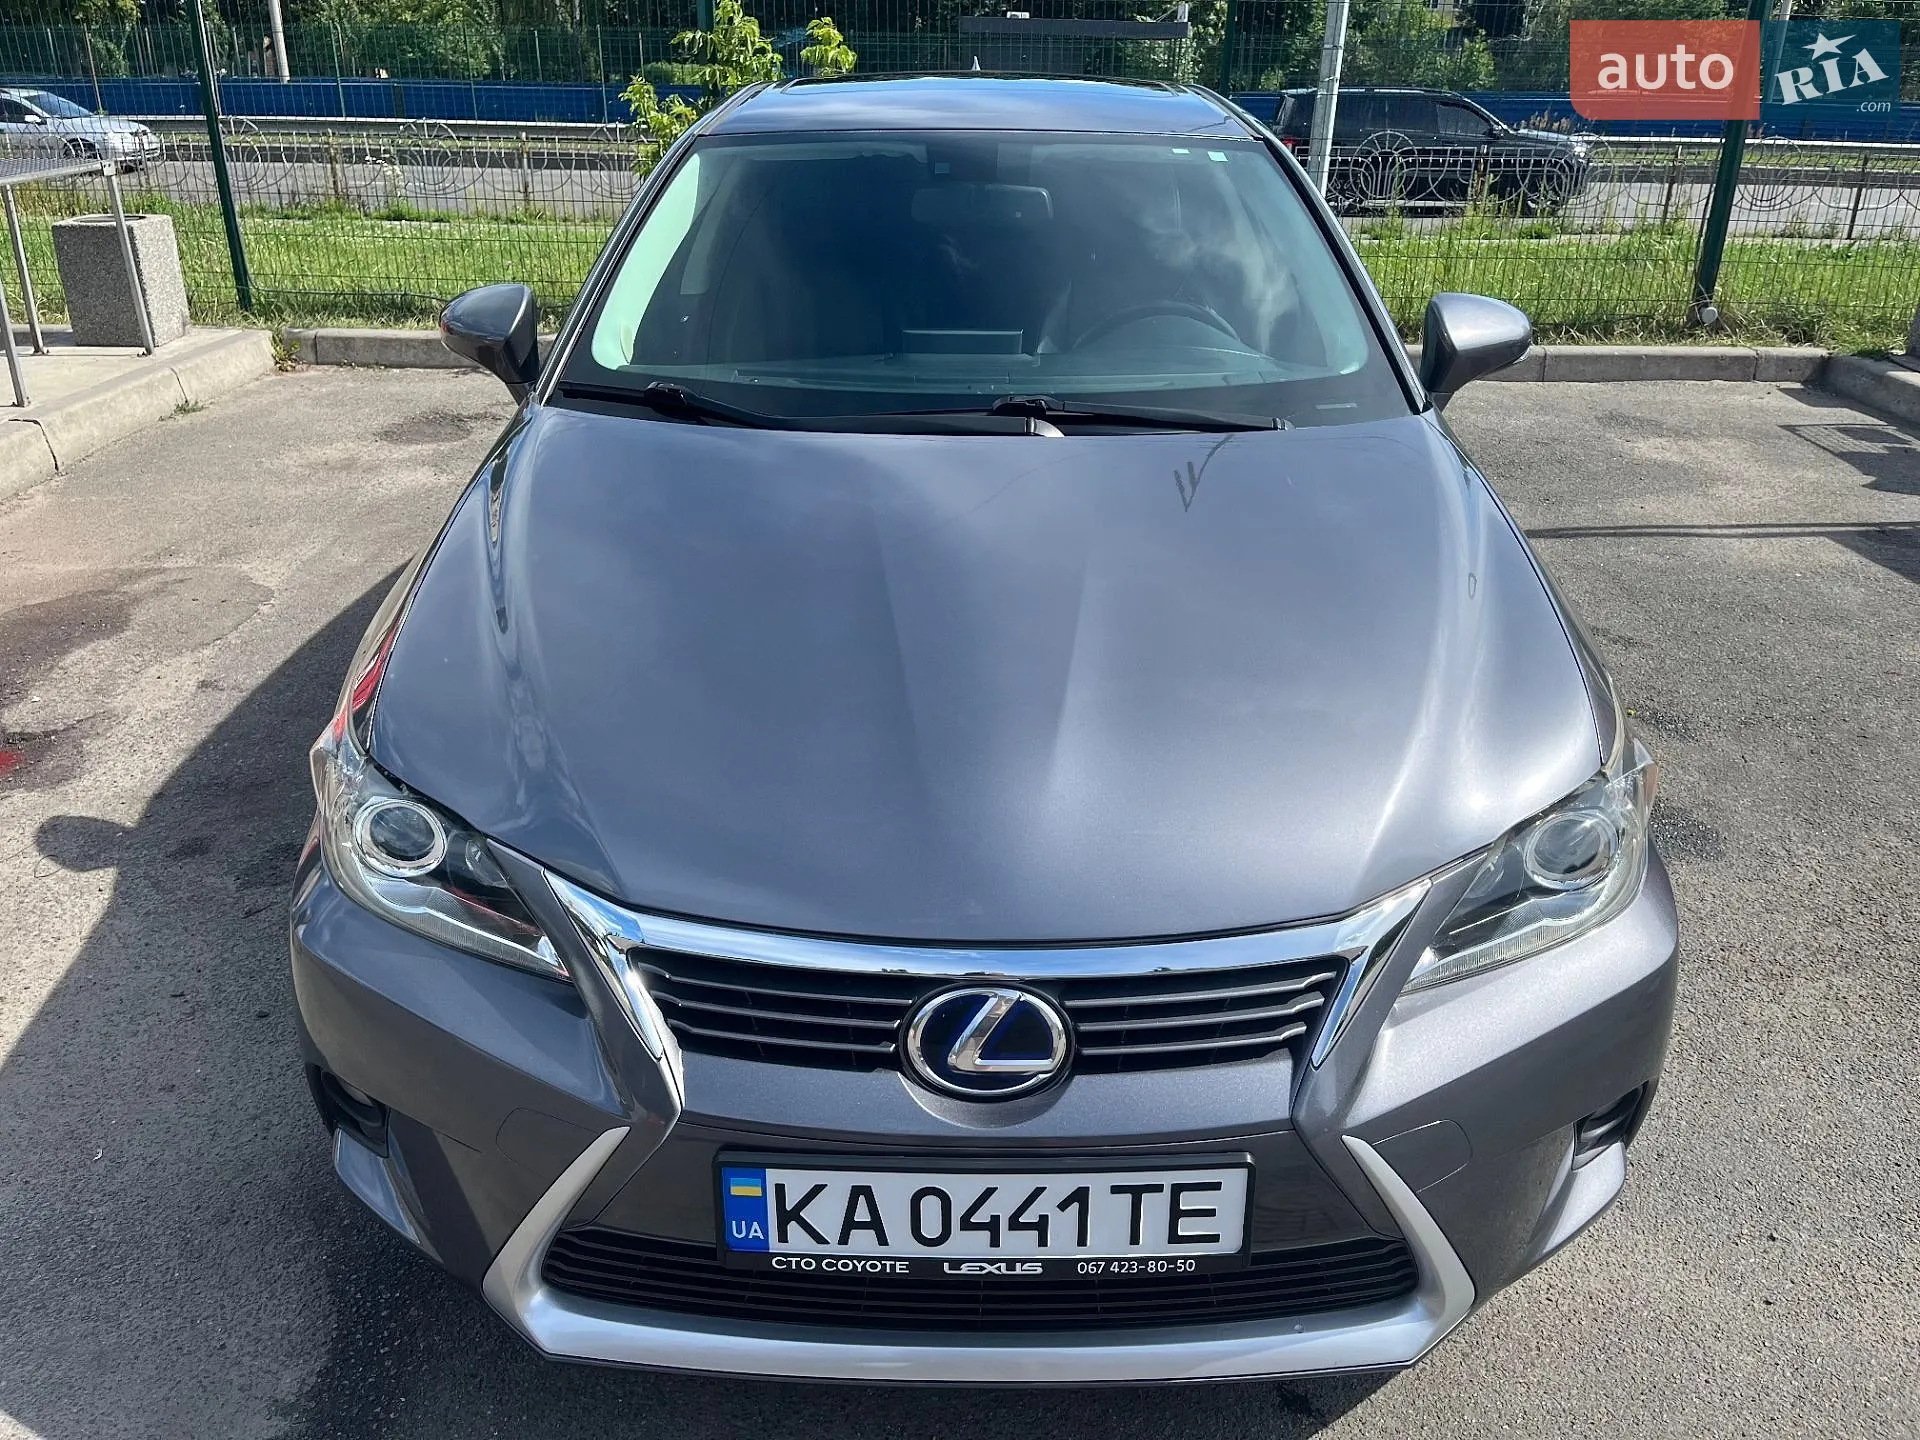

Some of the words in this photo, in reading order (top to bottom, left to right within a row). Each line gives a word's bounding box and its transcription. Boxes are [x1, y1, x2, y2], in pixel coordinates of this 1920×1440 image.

[774, 1182, 890, 1247] KA
[910, 1184, 1089, 1248] 0441
[1109, 1181, 1224, 1246] TE
[731, 1220, 765, 1241] UA
[821, 1258, 910, 1274] COYOTE
[943, 1262, 1044, 1275] LEXUS
[1077, 1261, 1106, 1274] 067
[1109, 1259, 1196, 1274] 423-80-50
